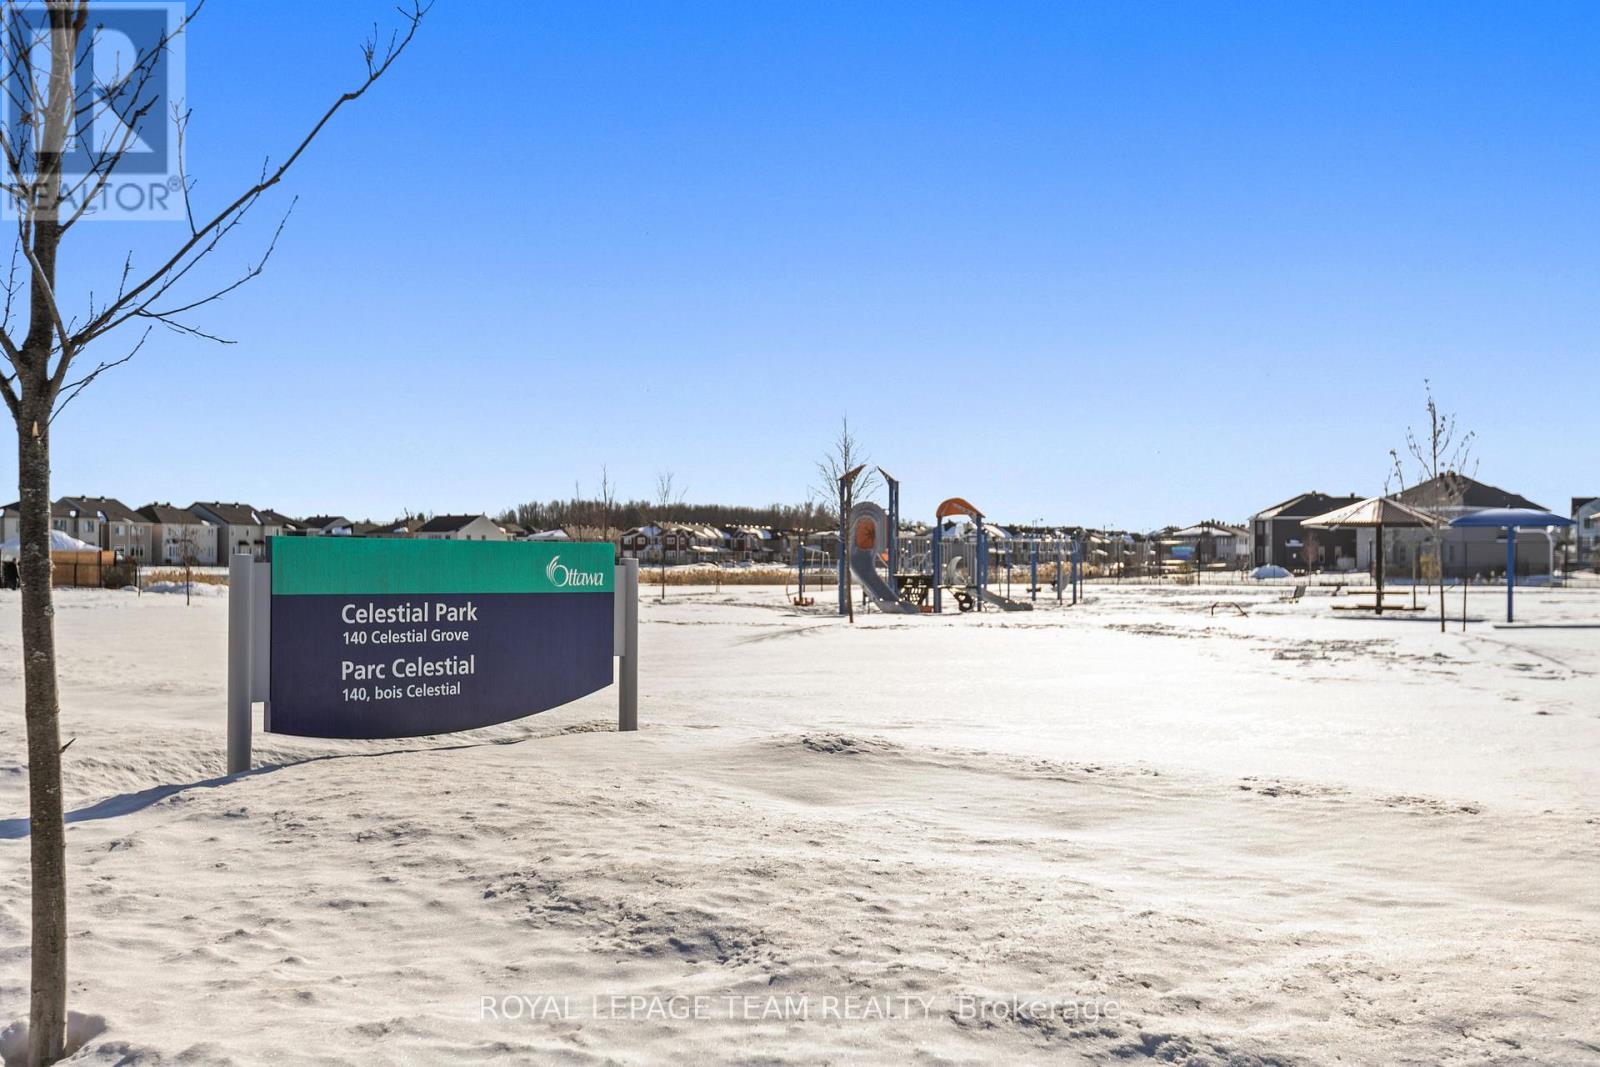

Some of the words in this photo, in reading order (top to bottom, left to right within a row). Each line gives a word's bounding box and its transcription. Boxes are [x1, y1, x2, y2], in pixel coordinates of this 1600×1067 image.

[546, 557, 604, 587] Ottawa
[341, 602, 429, 624] Celestial
[435, 601, 478, 622] Park
[342, 631, 367, 645] 140
[371, 629, 427, 643] Celestial
[431, 629, 469, 642] Grove
[341, 660, 385, 680] Parc
[391, 654, 475, 678] Celestial
[342, 687, 370, 703] 140,
[374, 685, 403, 700] bois
[406, 681, 461, 697] Celestial
